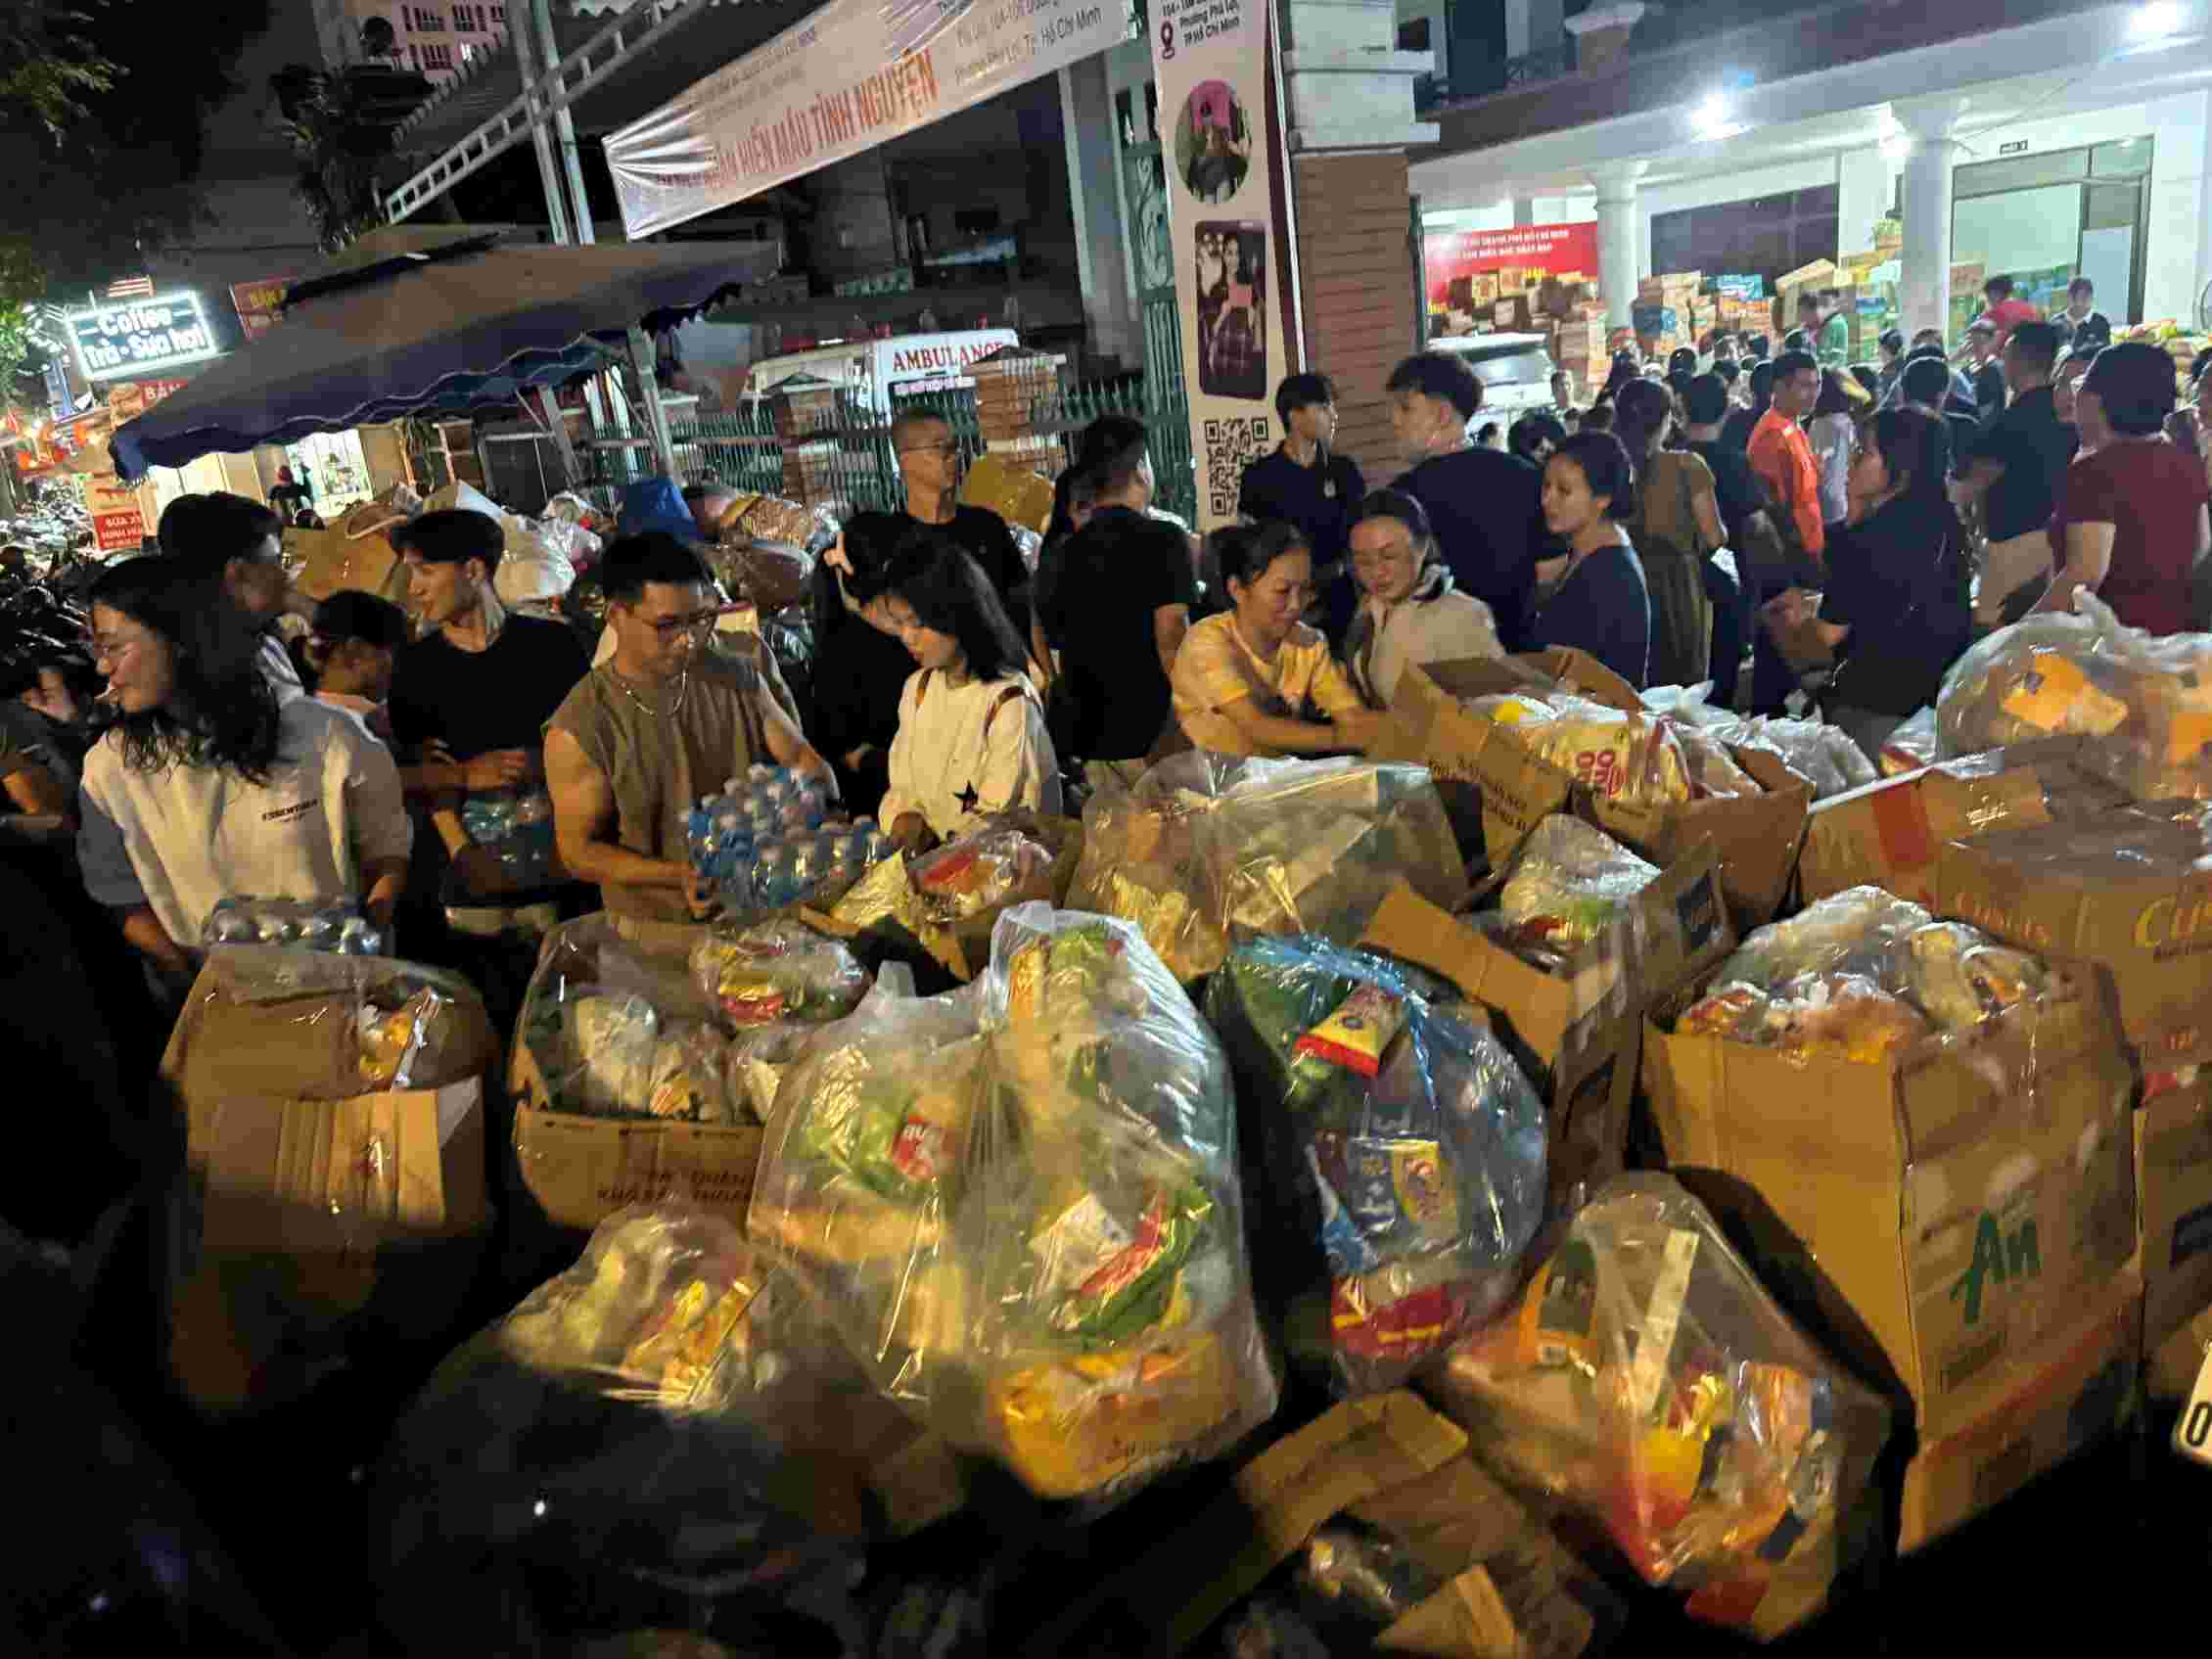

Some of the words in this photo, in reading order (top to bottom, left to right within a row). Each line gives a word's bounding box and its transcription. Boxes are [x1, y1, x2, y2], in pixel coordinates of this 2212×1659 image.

[1076, 7, 1103, 31] Minh
[777, 104, 816, 166] MÁU
[810, 86, 857, 150] TÌNH
[856, 46, 941, 132] NGUYỆN
